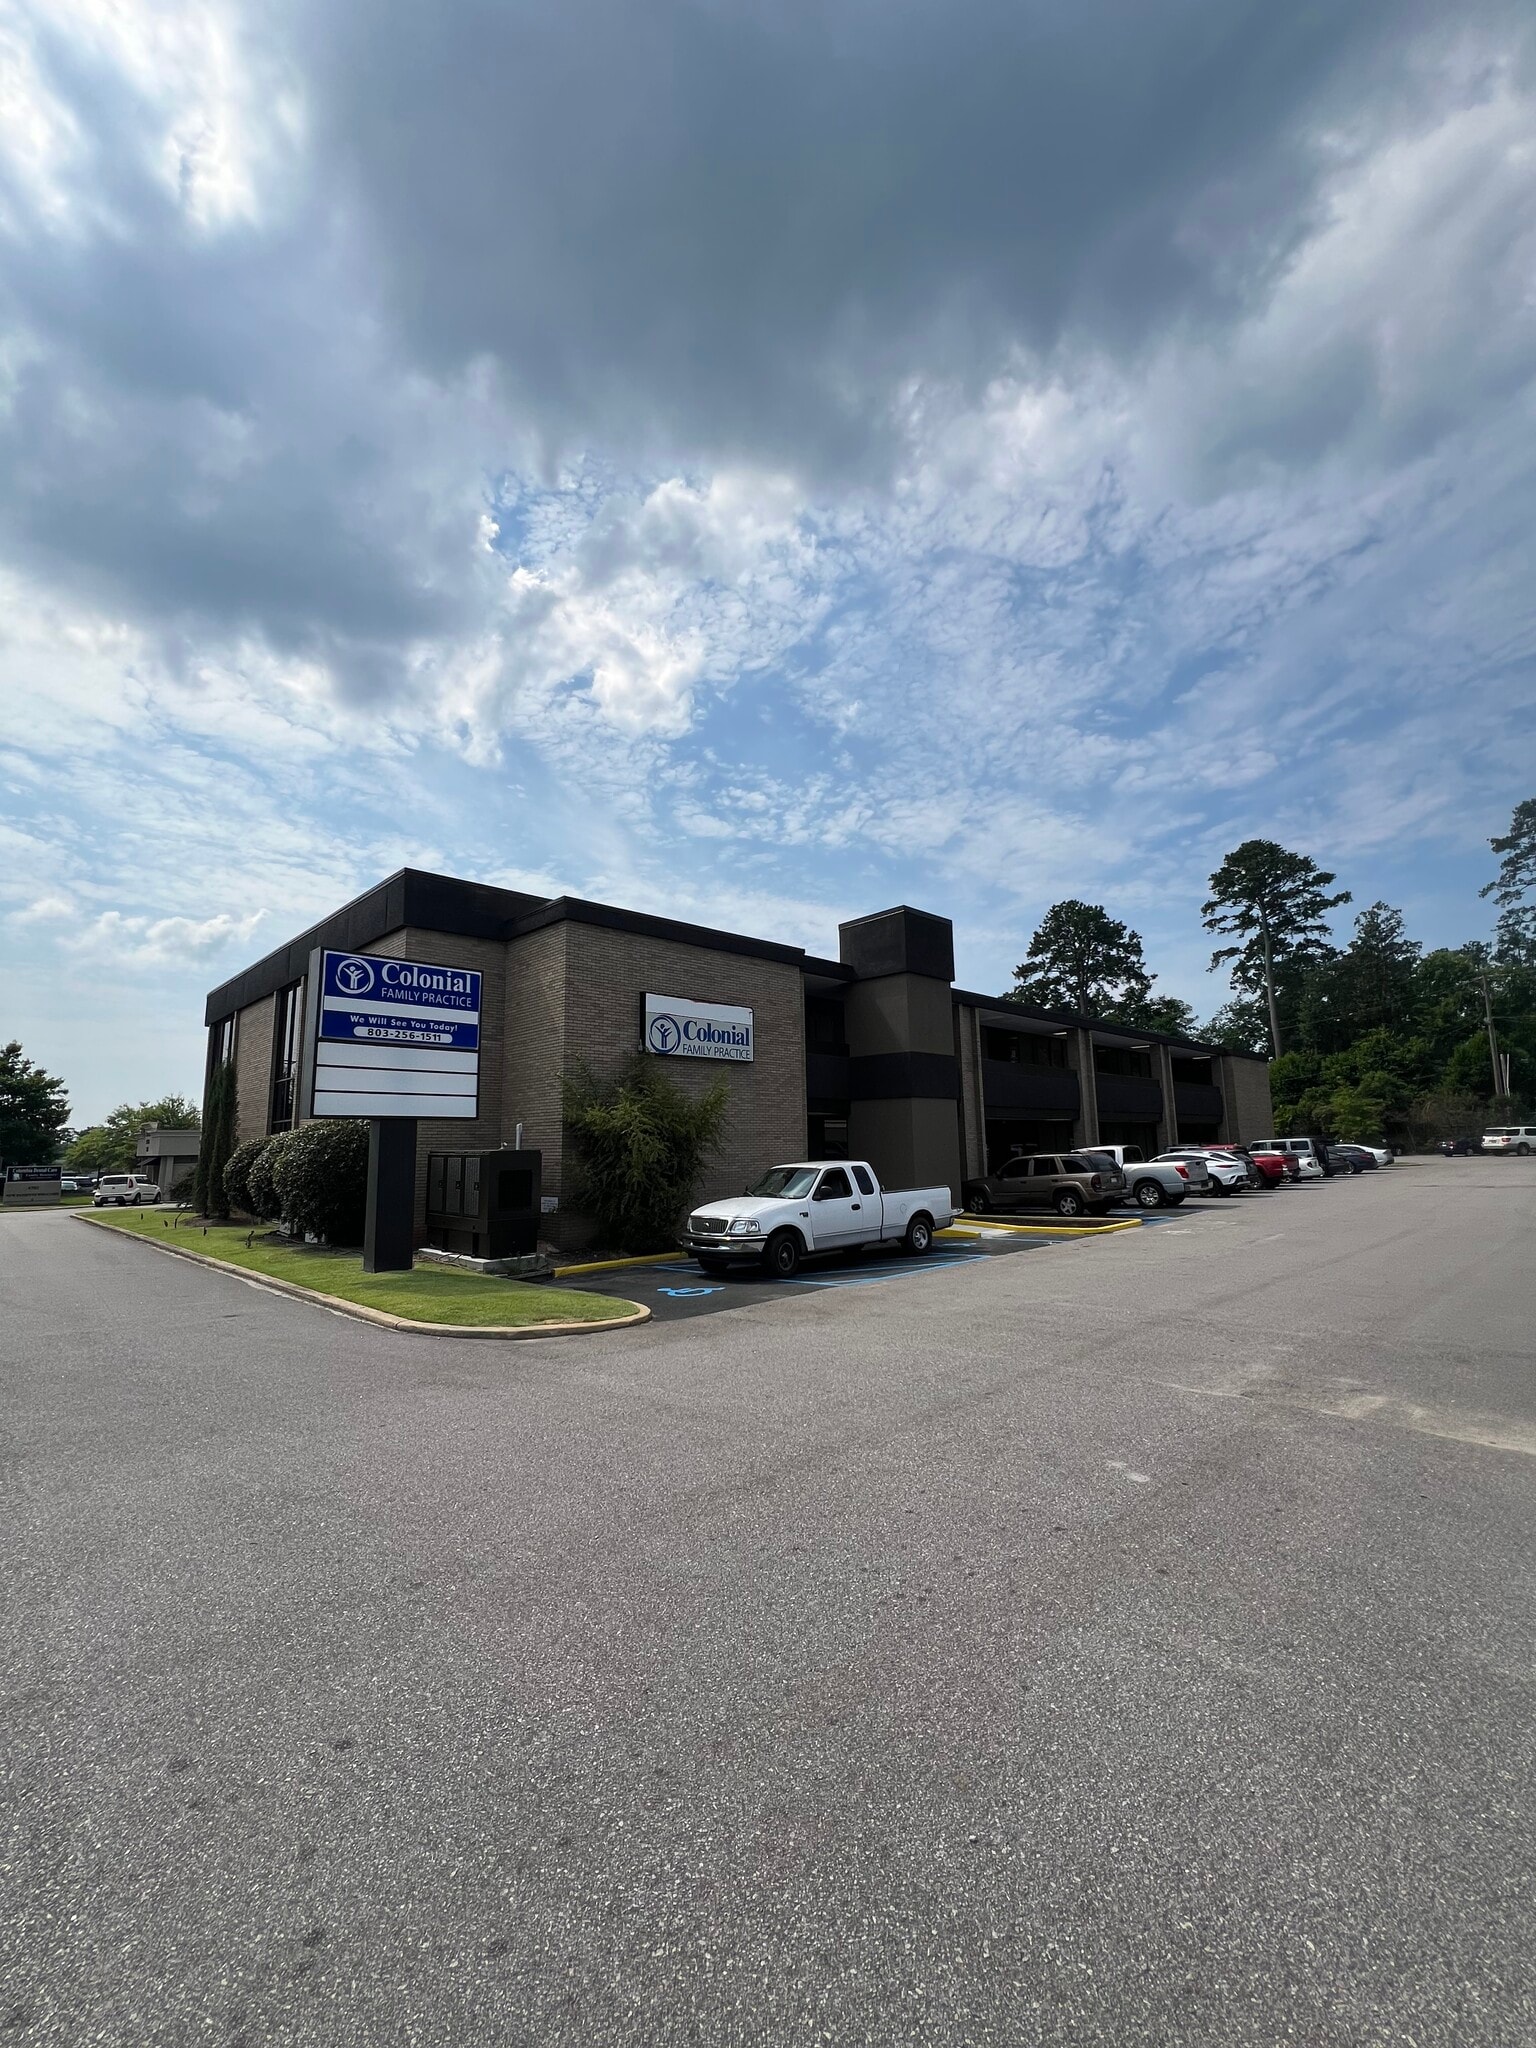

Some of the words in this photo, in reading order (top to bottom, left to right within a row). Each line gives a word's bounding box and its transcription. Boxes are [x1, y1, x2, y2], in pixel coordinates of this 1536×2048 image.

[381, 963, 472, 994] Colonial
[381, 987, 420, 1002] FAMILY
[422, 992, 472, 1008] PRACTICE
[350, 1015, 365, 1024] We
[368, 1016, 387, 1025] Will
[390, 1018, 407, 1027] See
[410, 1020, 427, 1029] You
[429, 1022, 458, 1033] Today!
[683, 1020, 750, 1047] Colonial
[367, 1028, 442, 1042] 803-256-1511
[682, 1043, 712, 1056] FAMILY
[714, 1047, 751, 1060] PRACTICE
